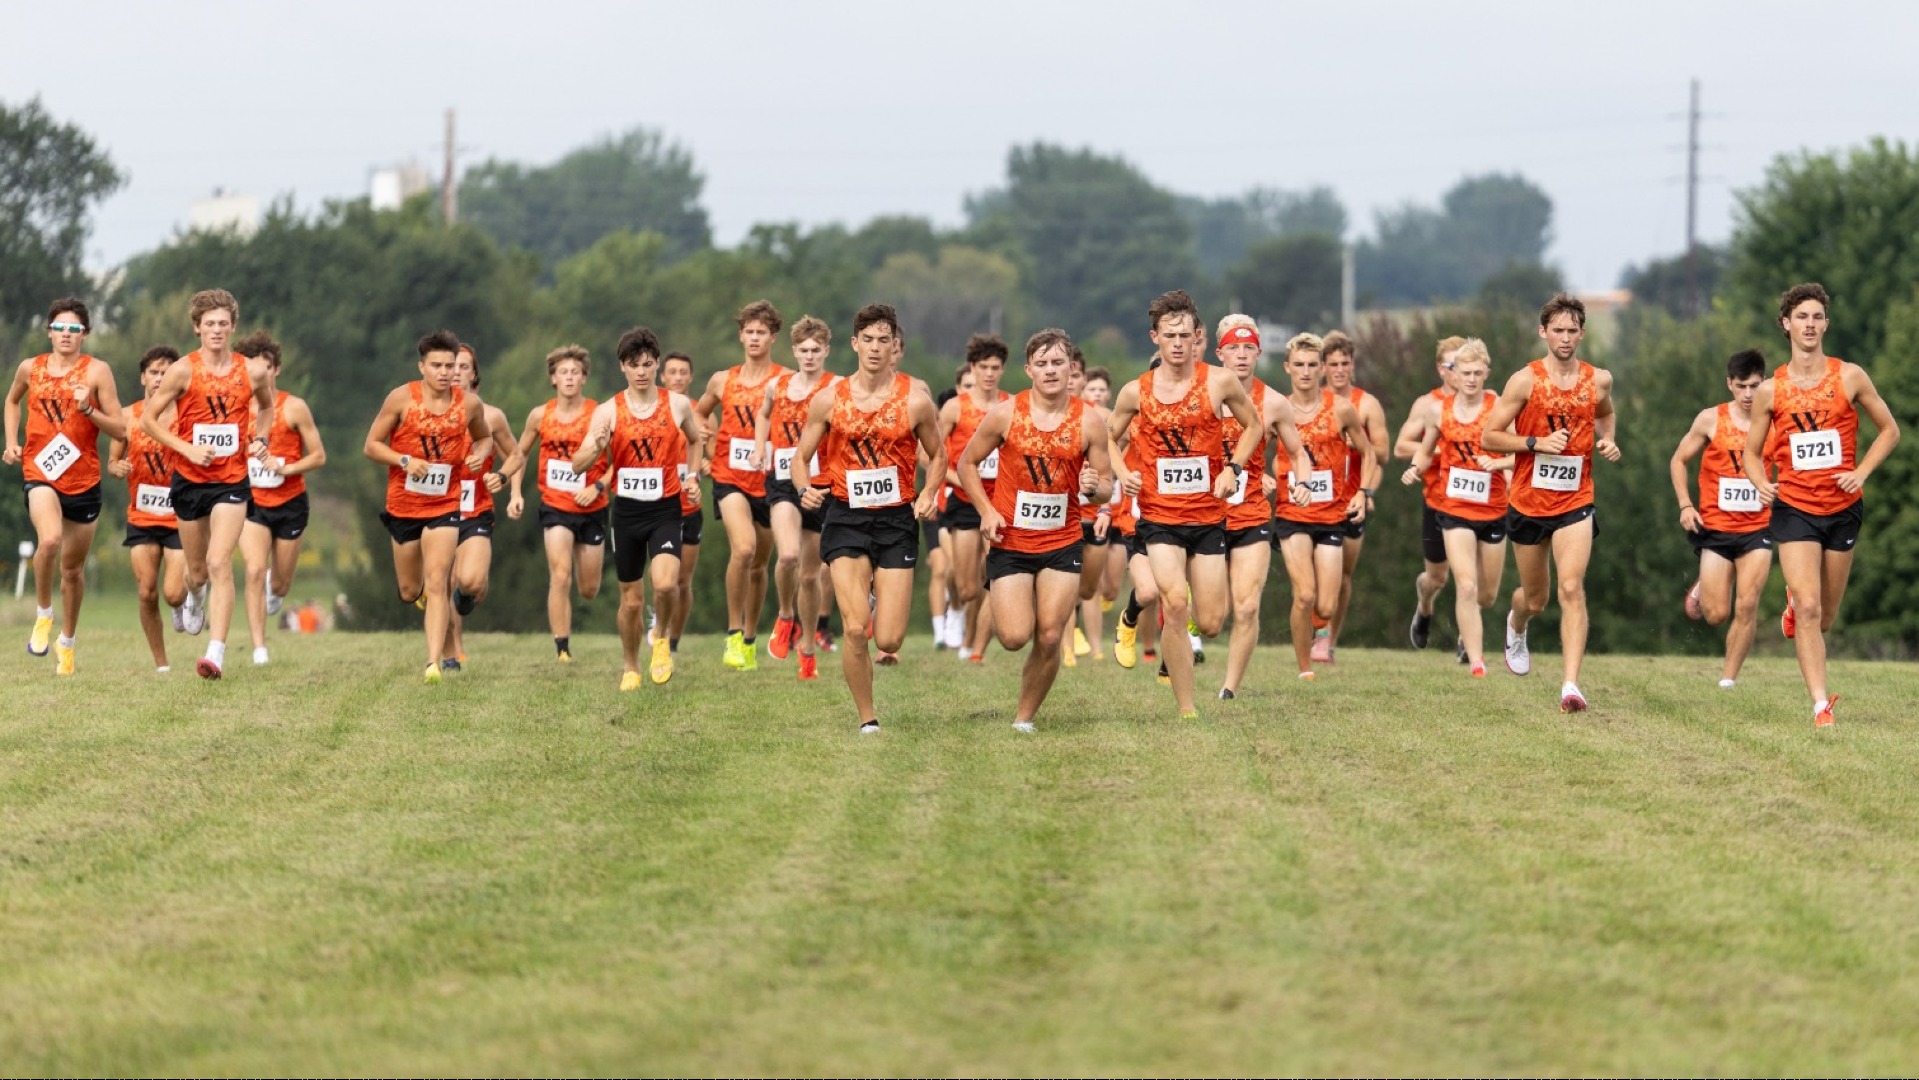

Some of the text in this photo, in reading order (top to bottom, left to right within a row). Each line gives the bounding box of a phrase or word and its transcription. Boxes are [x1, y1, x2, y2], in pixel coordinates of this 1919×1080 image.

[40, 399, 73, 424] W
[205, 396, 237, 419] W
[1790, 411, 1829, 432] W
[199, 434, 233, 447] 5703
[420, 435, 448, 458] W
[630, 437, 662, 461] W
[1158, 427, 1195, 455] W
[1796, 441, 1834, 459] 5721
[43, 444, 71, 472] 5733
[849, 438, 887, 467] W
[143, 452, 173, 475] W
[1024, 455, 1062, 486] W
[1539, 464, 1577, 480] 5728
[552, 469, 580, 483] 5722
[623, 478, 658, 490] 5719
[1163, 468, 1203, 483] 5734
[1453, 477, 1485, 493] 5710
[853, 478, 893, 496] 5706
[1724, 488, 1757, 501] 5701
[1021, 503, 1061, 519] 5732
